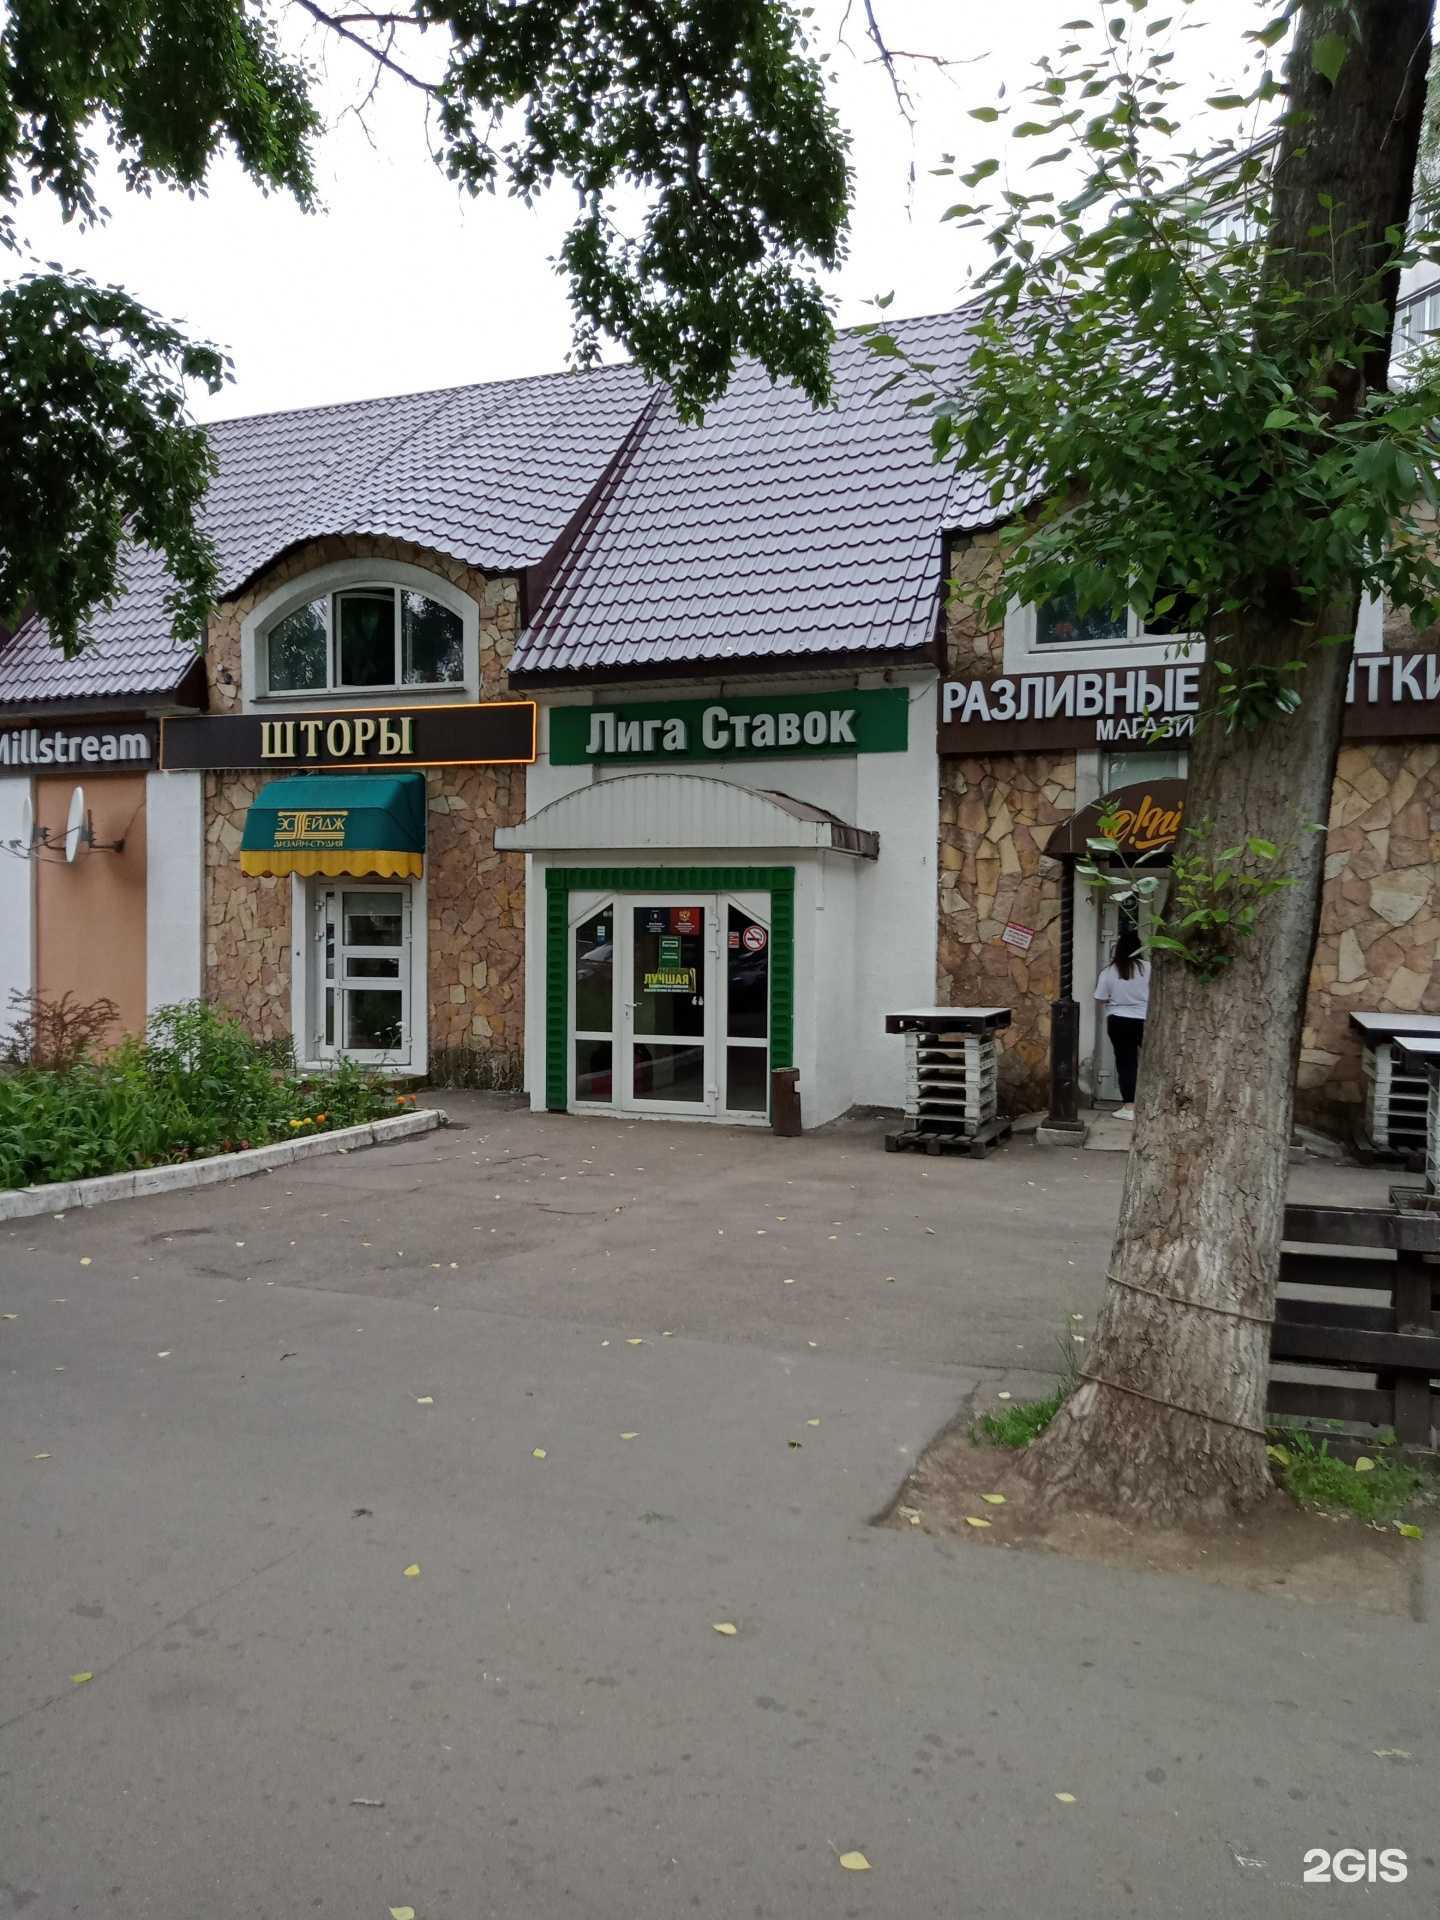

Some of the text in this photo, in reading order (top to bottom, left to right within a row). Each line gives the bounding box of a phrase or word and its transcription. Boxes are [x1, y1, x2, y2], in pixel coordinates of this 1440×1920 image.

[942, 654, 1440, 723] РАЗЛИВНЫЕ ТК
[260, 717, 415, 758] ШТОРЫ
[586, 705, 857, 754] Лига Ставок
[1096, 714, 1195, 741] МАГАЗИ
[643, 973, 689, 985] ЛУЧШАЯ
